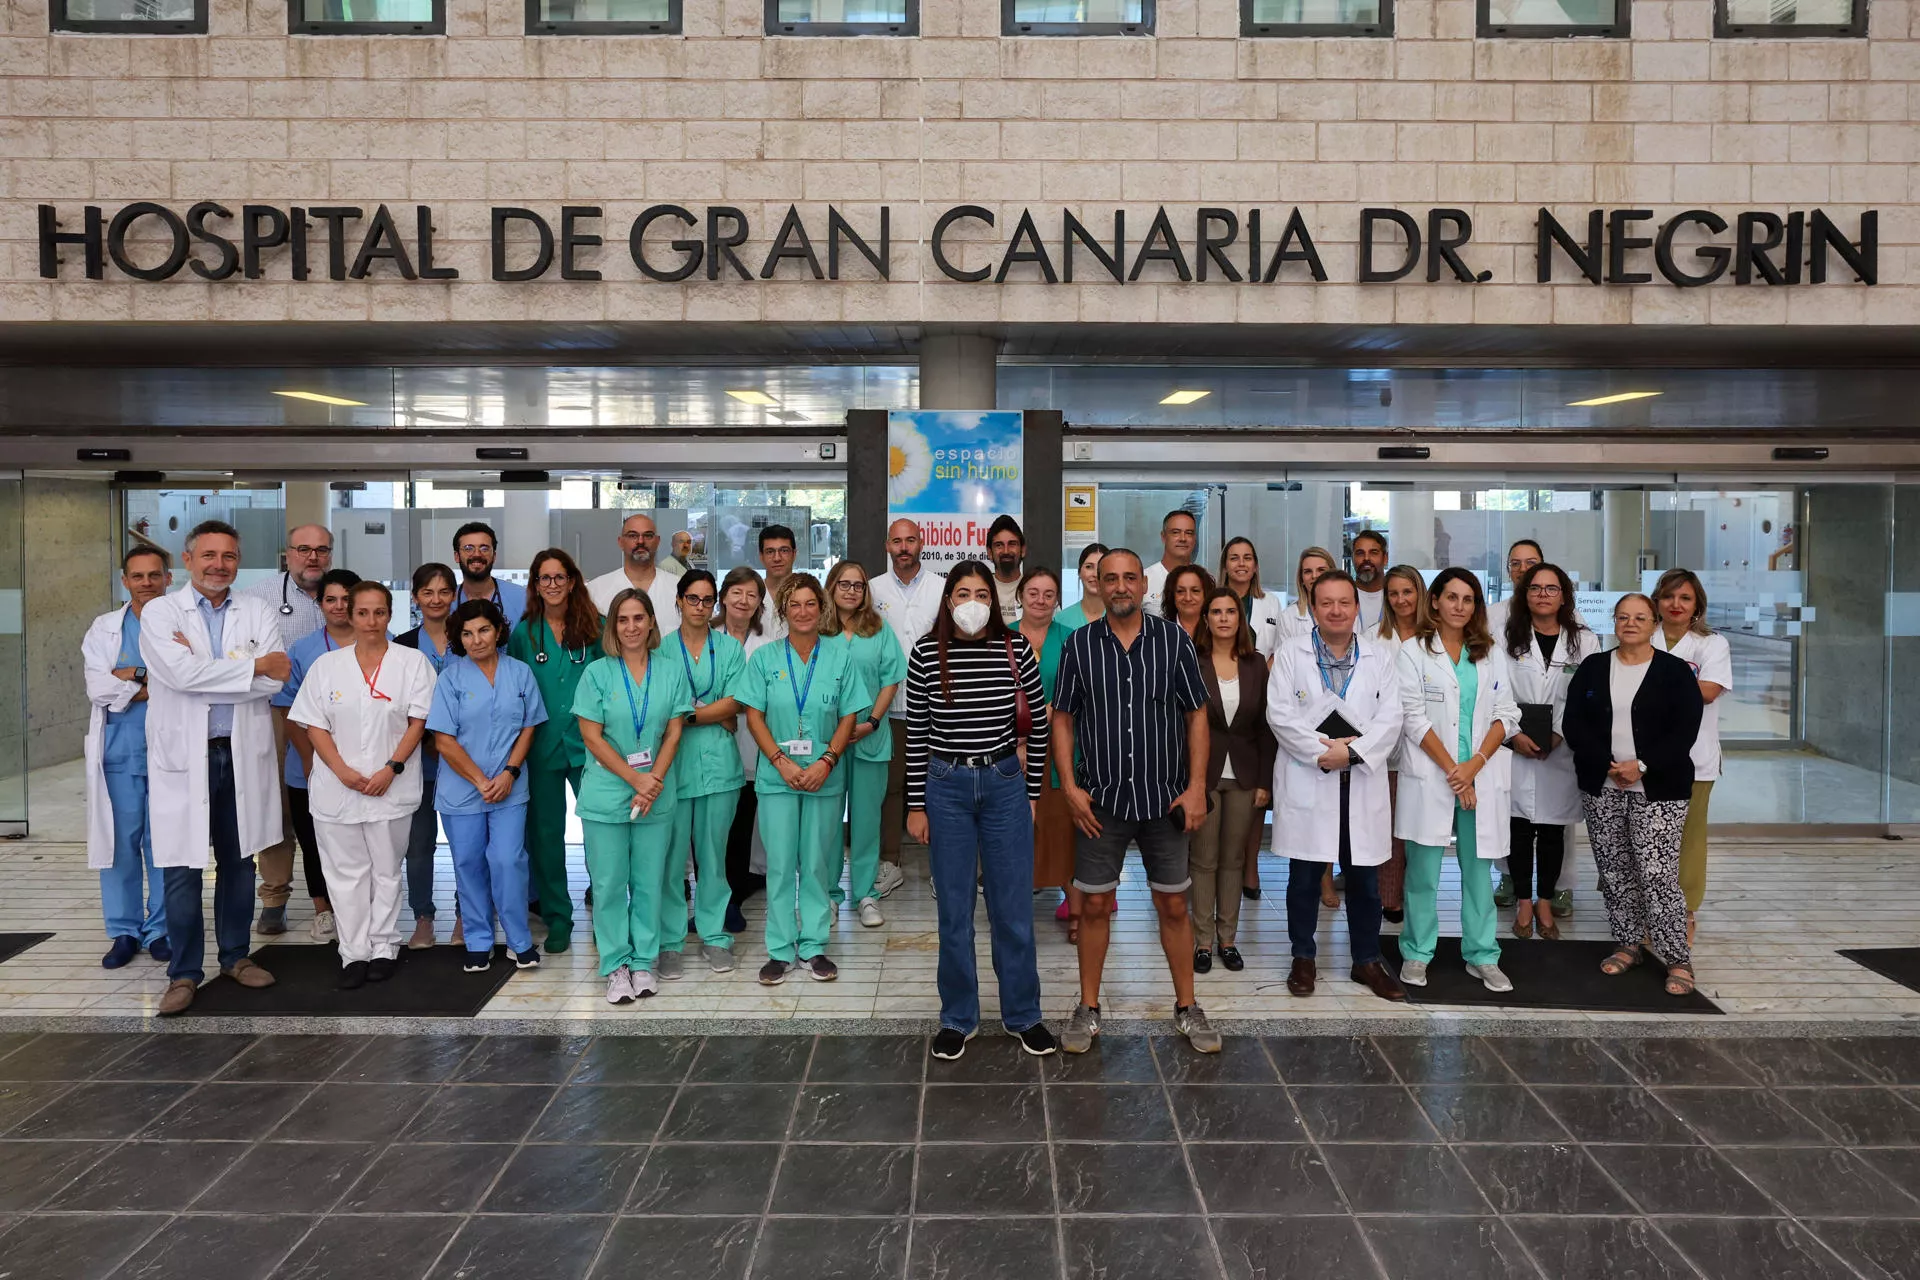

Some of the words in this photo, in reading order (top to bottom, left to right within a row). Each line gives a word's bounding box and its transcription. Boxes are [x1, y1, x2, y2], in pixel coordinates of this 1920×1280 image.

[38, 201, 459, 280] HOSPITAL
[491, 205, 603, 281] DE
[629, 202, 889, 282] GRAN
[931, 204, 1328, 285] CANARIA
[1359, 207, 1493, 284] DR.
[1536, 206, 1879, 288] NEGRIN
[935, 449, 1017, 464] espacio
[935, 461, 961, 479] sin
[967, 461, 1019, 480] humo
[921, 551, 943, 561] 2010,
[944, 551, 954, 561] de
[956, 551, 966, 561] 30
[967, 551, 977, 561] de
